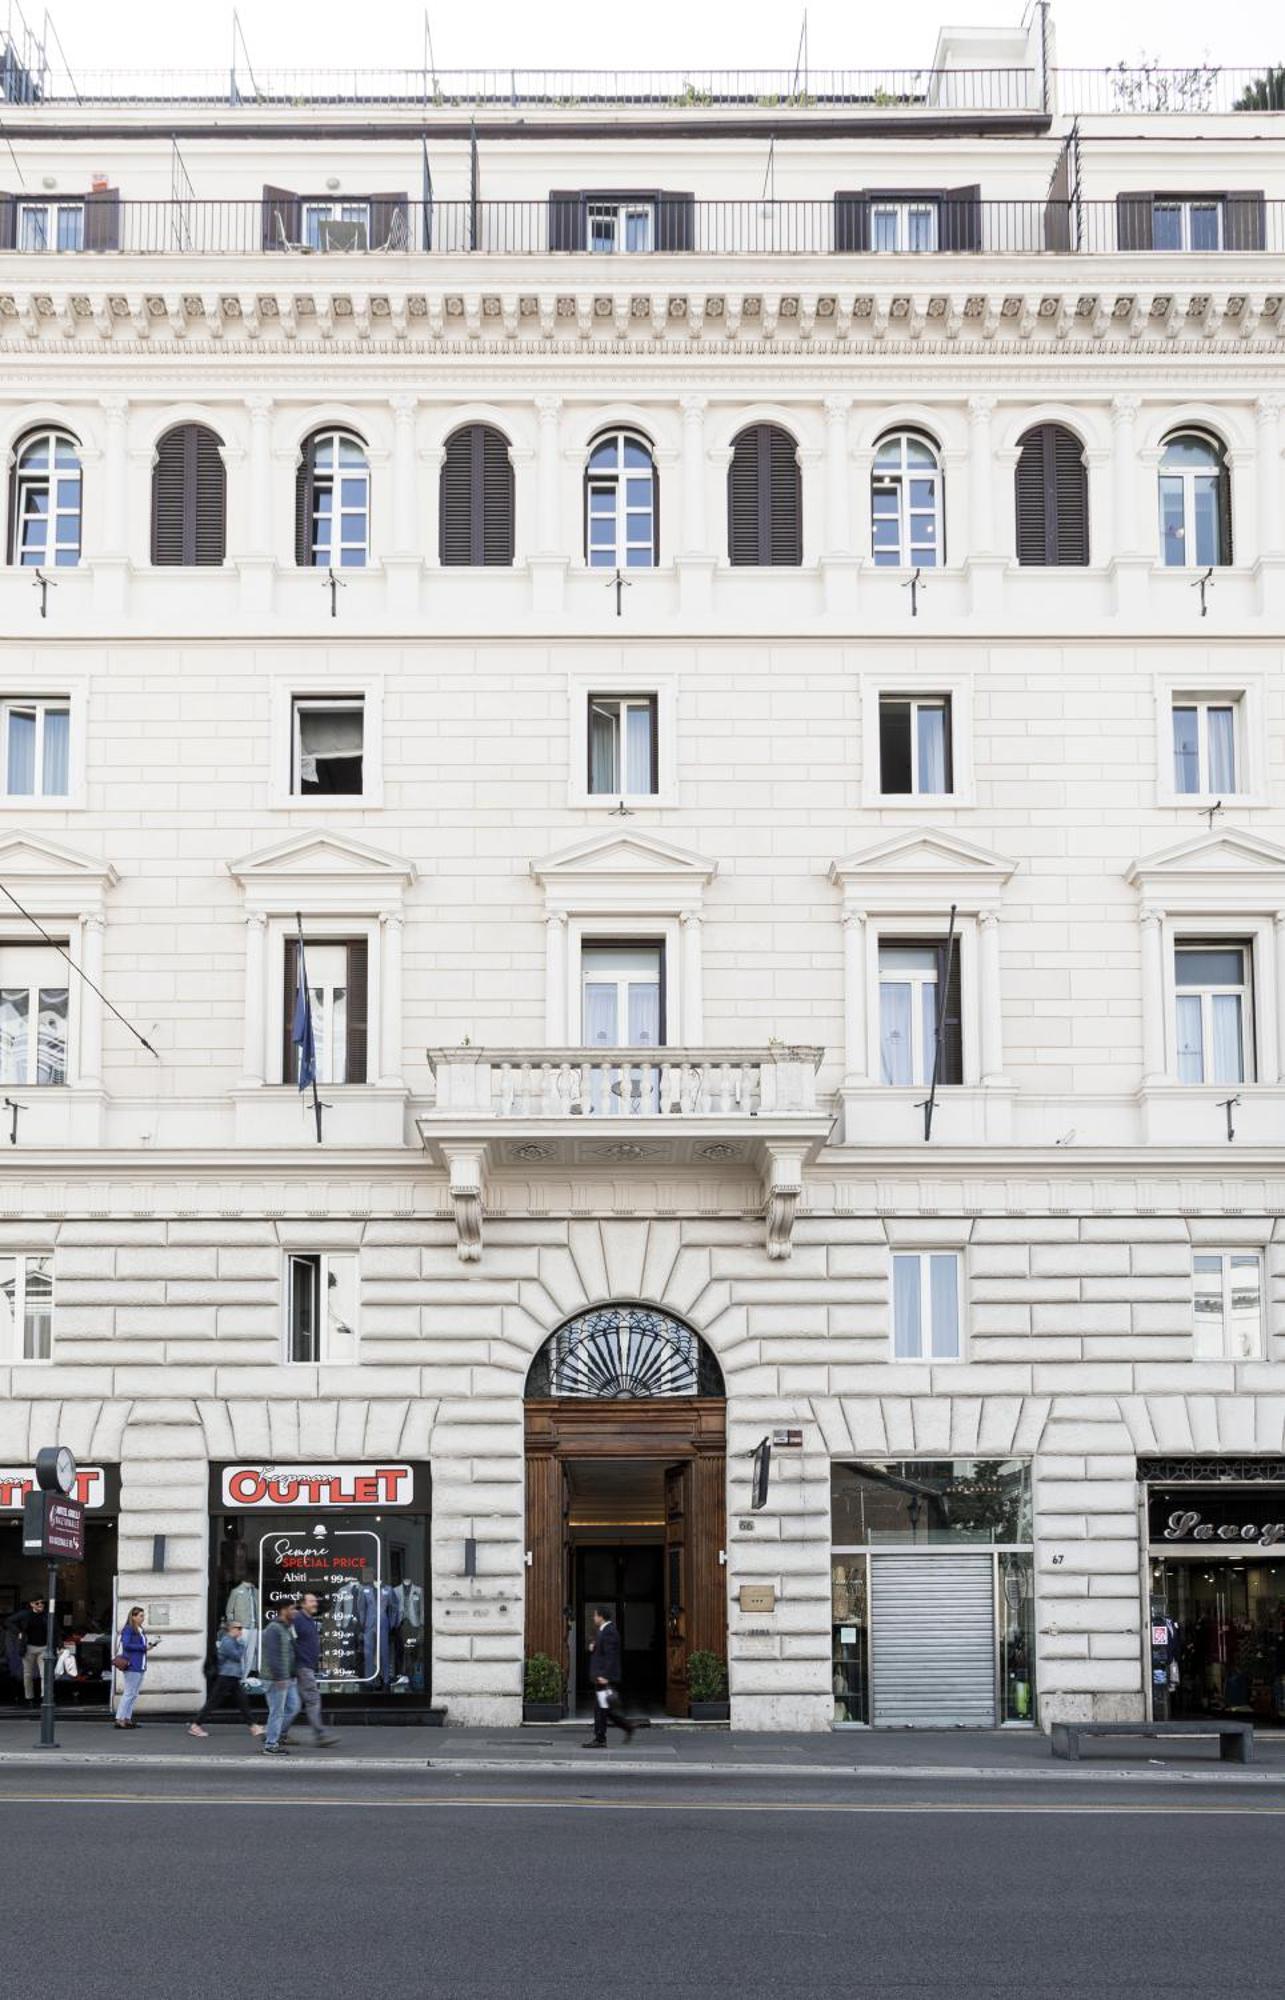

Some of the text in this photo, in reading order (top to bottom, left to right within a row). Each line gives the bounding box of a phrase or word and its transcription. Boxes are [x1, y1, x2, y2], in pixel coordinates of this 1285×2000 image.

[228, 1469, 408, 1504] OUTLET
[274, 1538, 330, 1565] Sempre
[282, 1557, 367, 1568] SPECIAL PRICE
[1052, 1555, 1065, 1565] 67
[283, 1572, 307, 1582] Abiti
